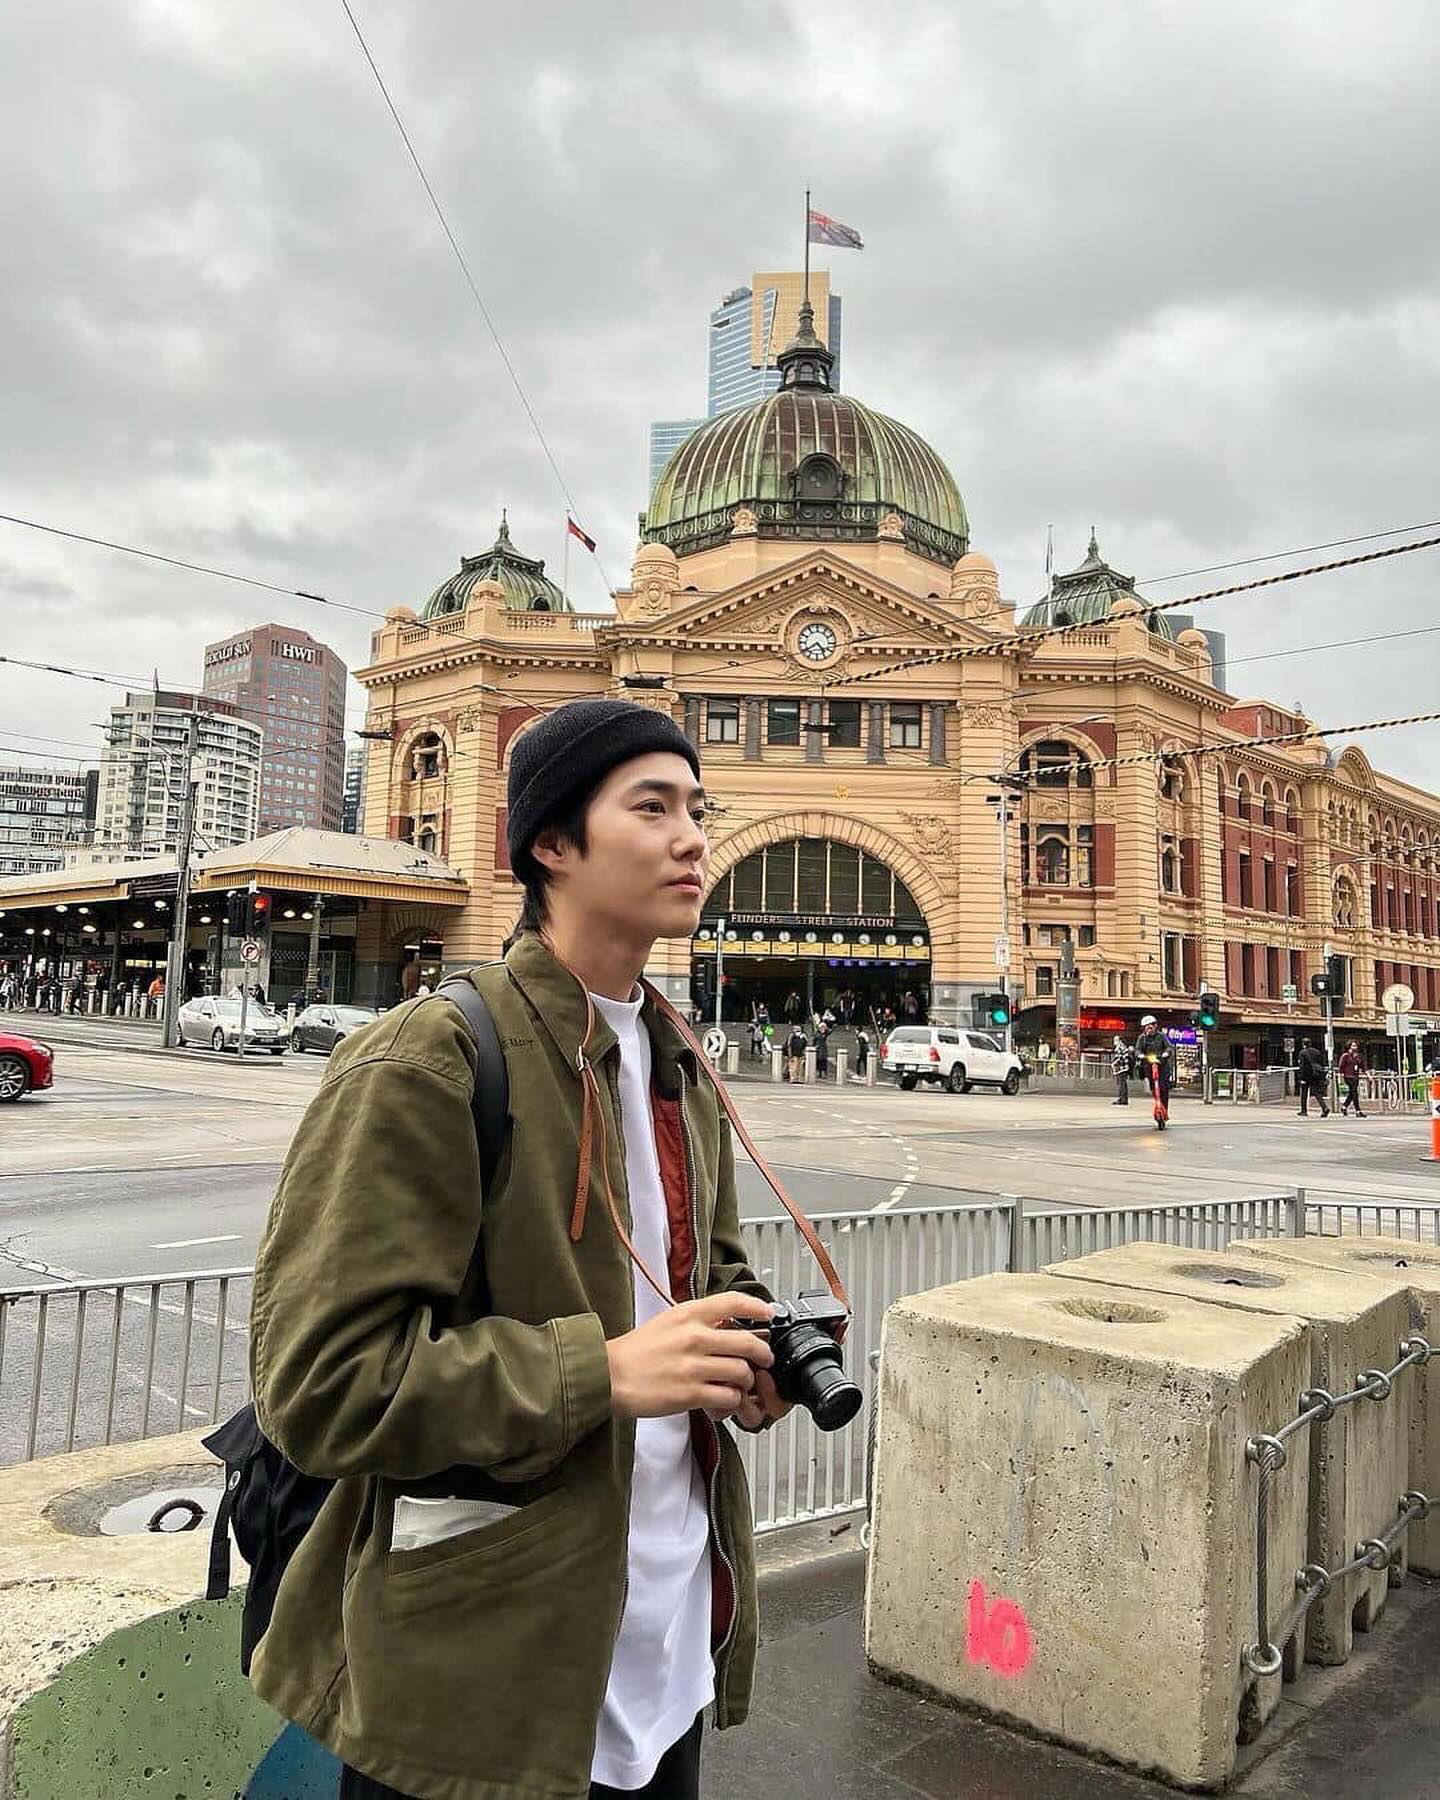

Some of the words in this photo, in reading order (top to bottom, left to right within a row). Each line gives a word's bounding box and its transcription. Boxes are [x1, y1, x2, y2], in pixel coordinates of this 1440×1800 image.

[282, 642, 316, 662] HWT
[731, 913, 782, 924] FLINDERS
[795, 915, 833, 926] STREET
[847, 917, 895, 927] STATION
